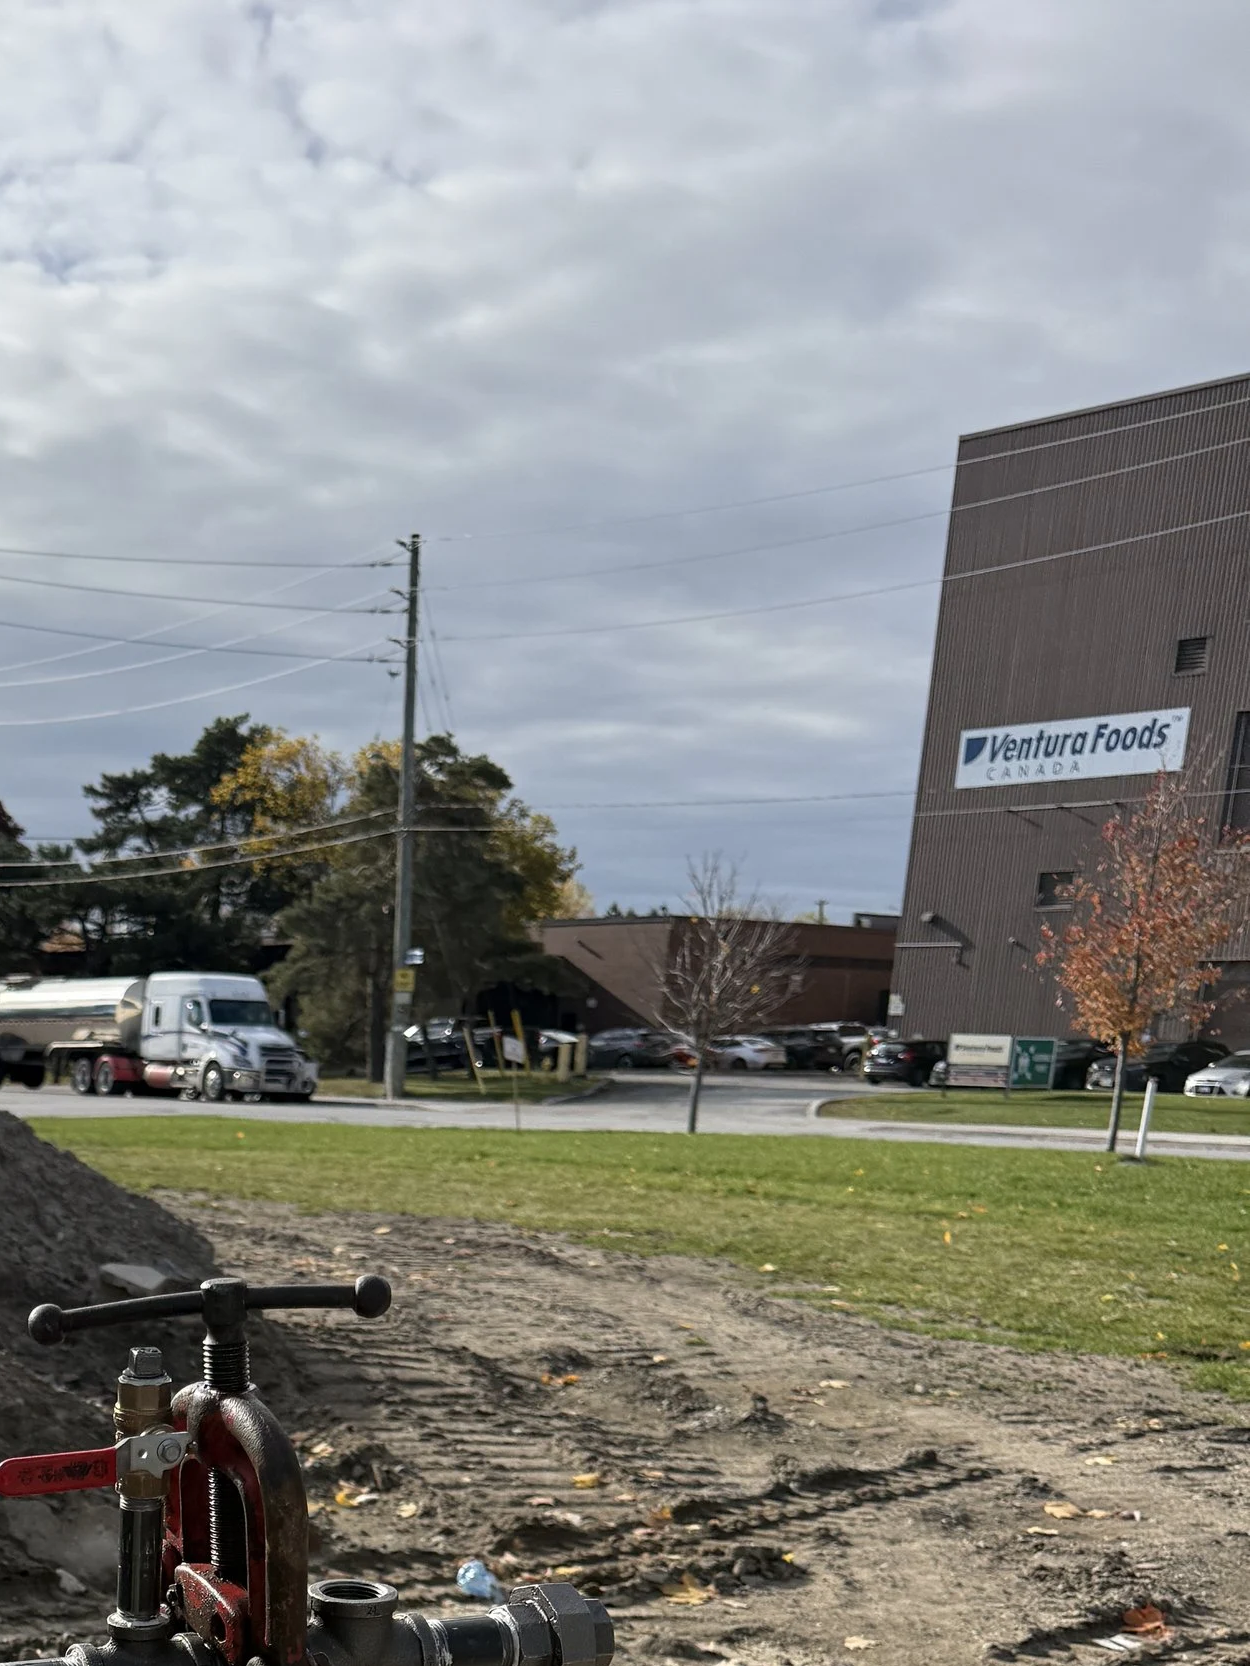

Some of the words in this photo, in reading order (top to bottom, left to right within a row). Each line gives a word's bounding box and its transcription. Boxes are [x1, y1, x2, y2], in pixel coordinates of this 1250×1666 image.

[989, 729, 1088, 764] Ventura
[1091, 718, 1171, 755] Foods
[986, 760, 1081, 782] CANADA
